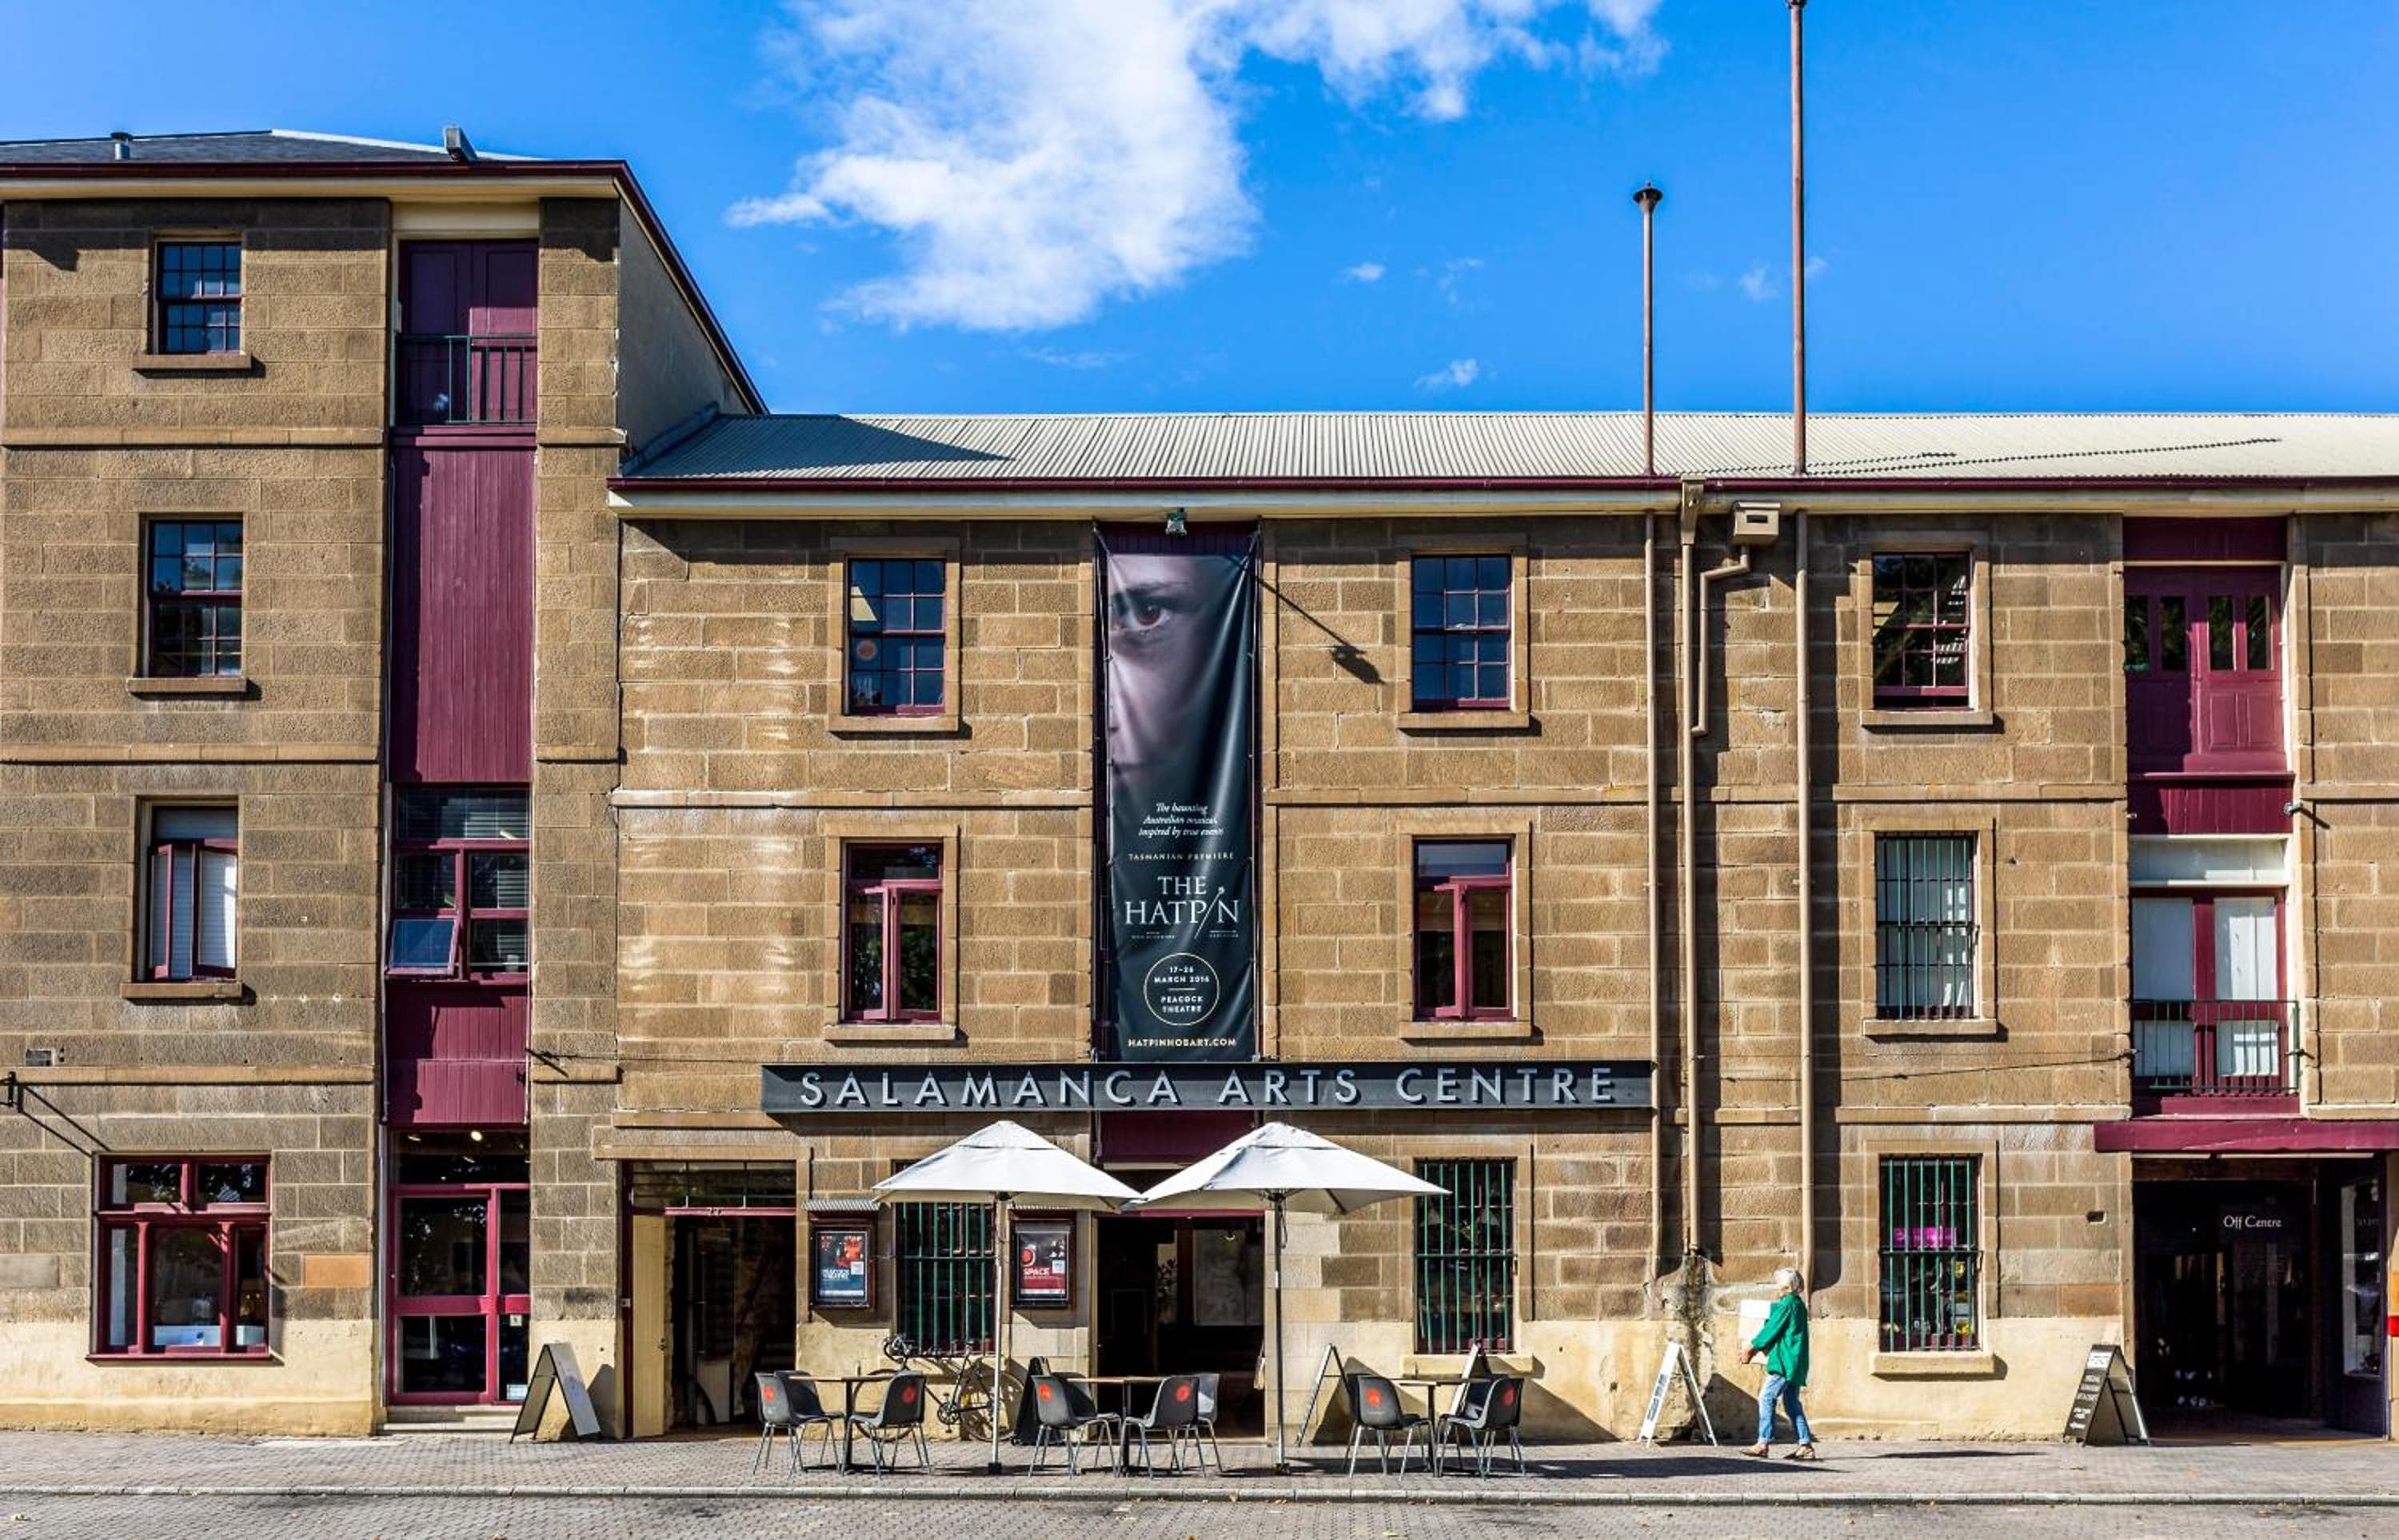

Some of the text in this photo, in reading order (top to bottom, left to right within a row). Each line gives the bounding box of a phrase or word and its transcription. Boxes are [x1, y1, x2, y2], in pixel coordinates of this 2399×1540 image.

[1156, 802, 1208, 816] The haunting
[1143, 814, 1184, 824] Australian
[1138, 827, 1171, 839] inspired
[1172, 826, 1181, 839] by
[1157, 876, 1207, 895] THE
[1128, 1039, 1236, 1047] HATPINHOBART.COM
[800, 1067, 1615, 1107] SALAMANCA ARTS CENTRE
[2223, 1215, 2282, 1229] Off Centre
